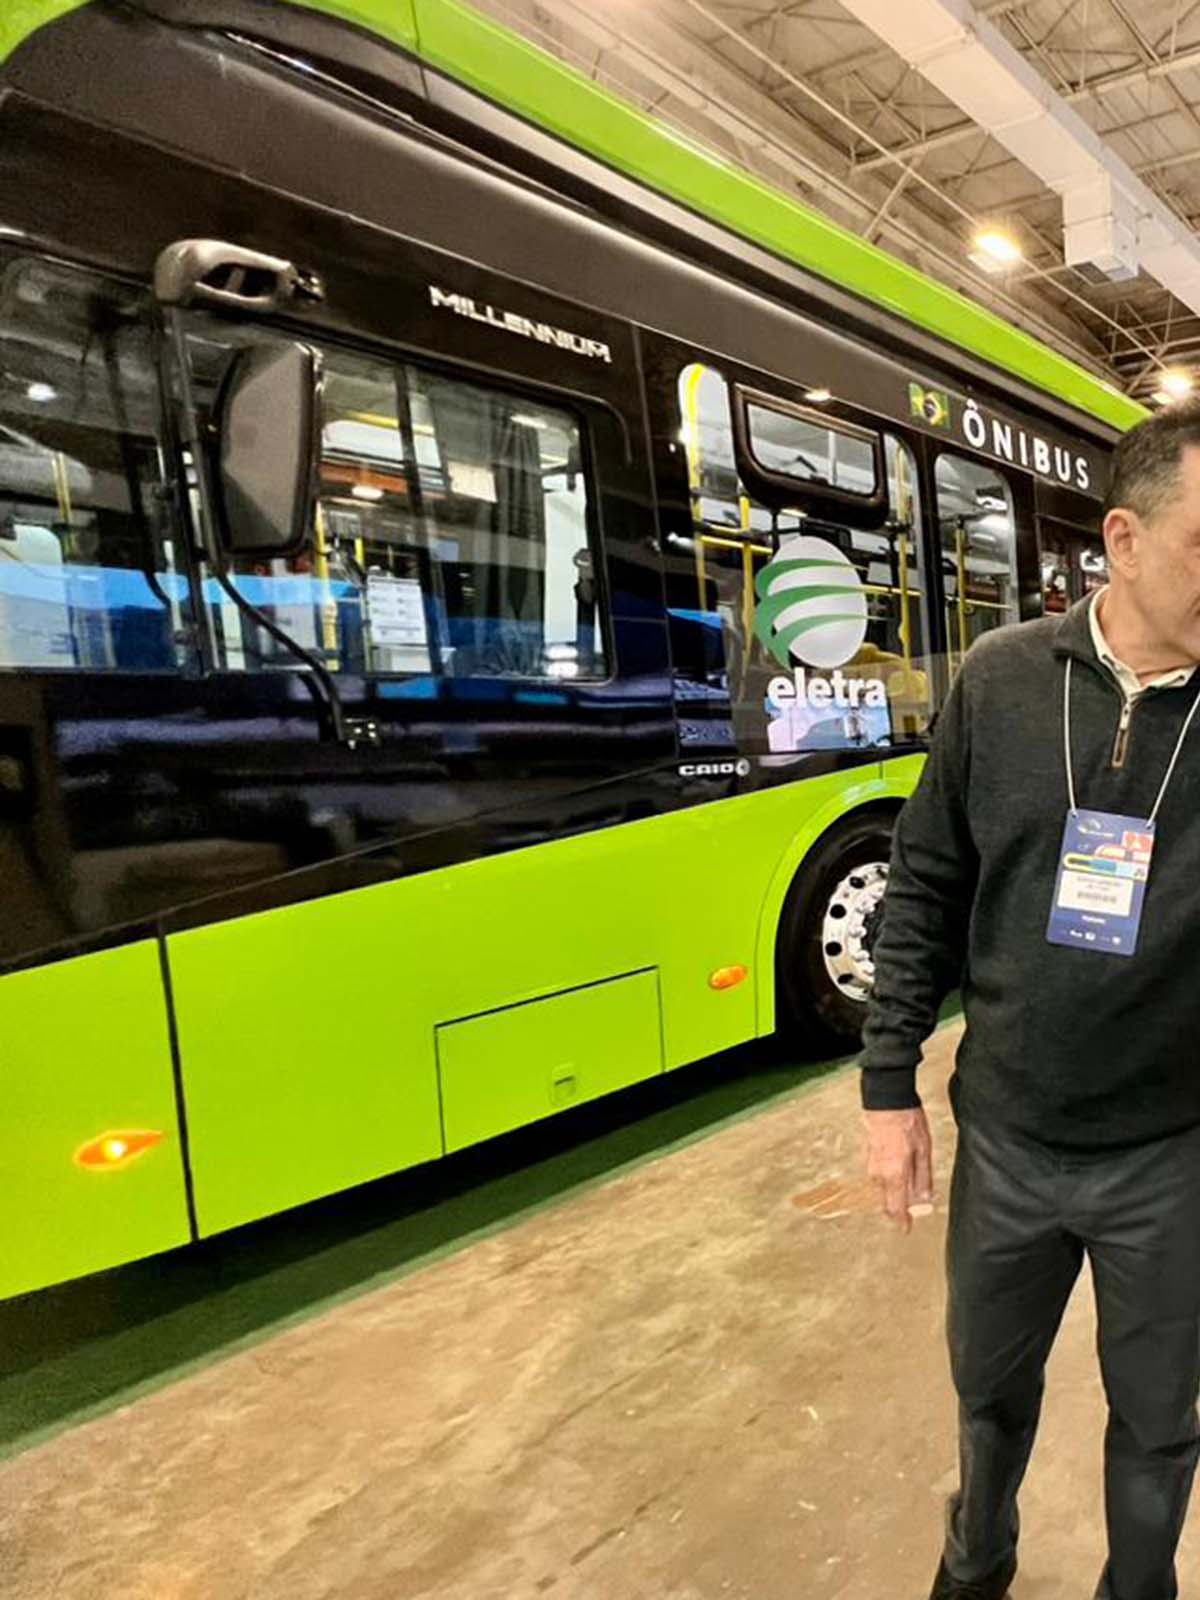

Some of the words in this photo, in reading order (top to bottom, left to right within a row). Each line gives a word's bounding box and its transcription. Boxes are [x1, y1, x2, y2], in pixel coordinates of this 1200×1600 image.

[428, 285, 613, 364] MILLENNIUM
[962, 398, 1090, 490] ÔNIBUS
[767, 667, 888, 709] eletra
